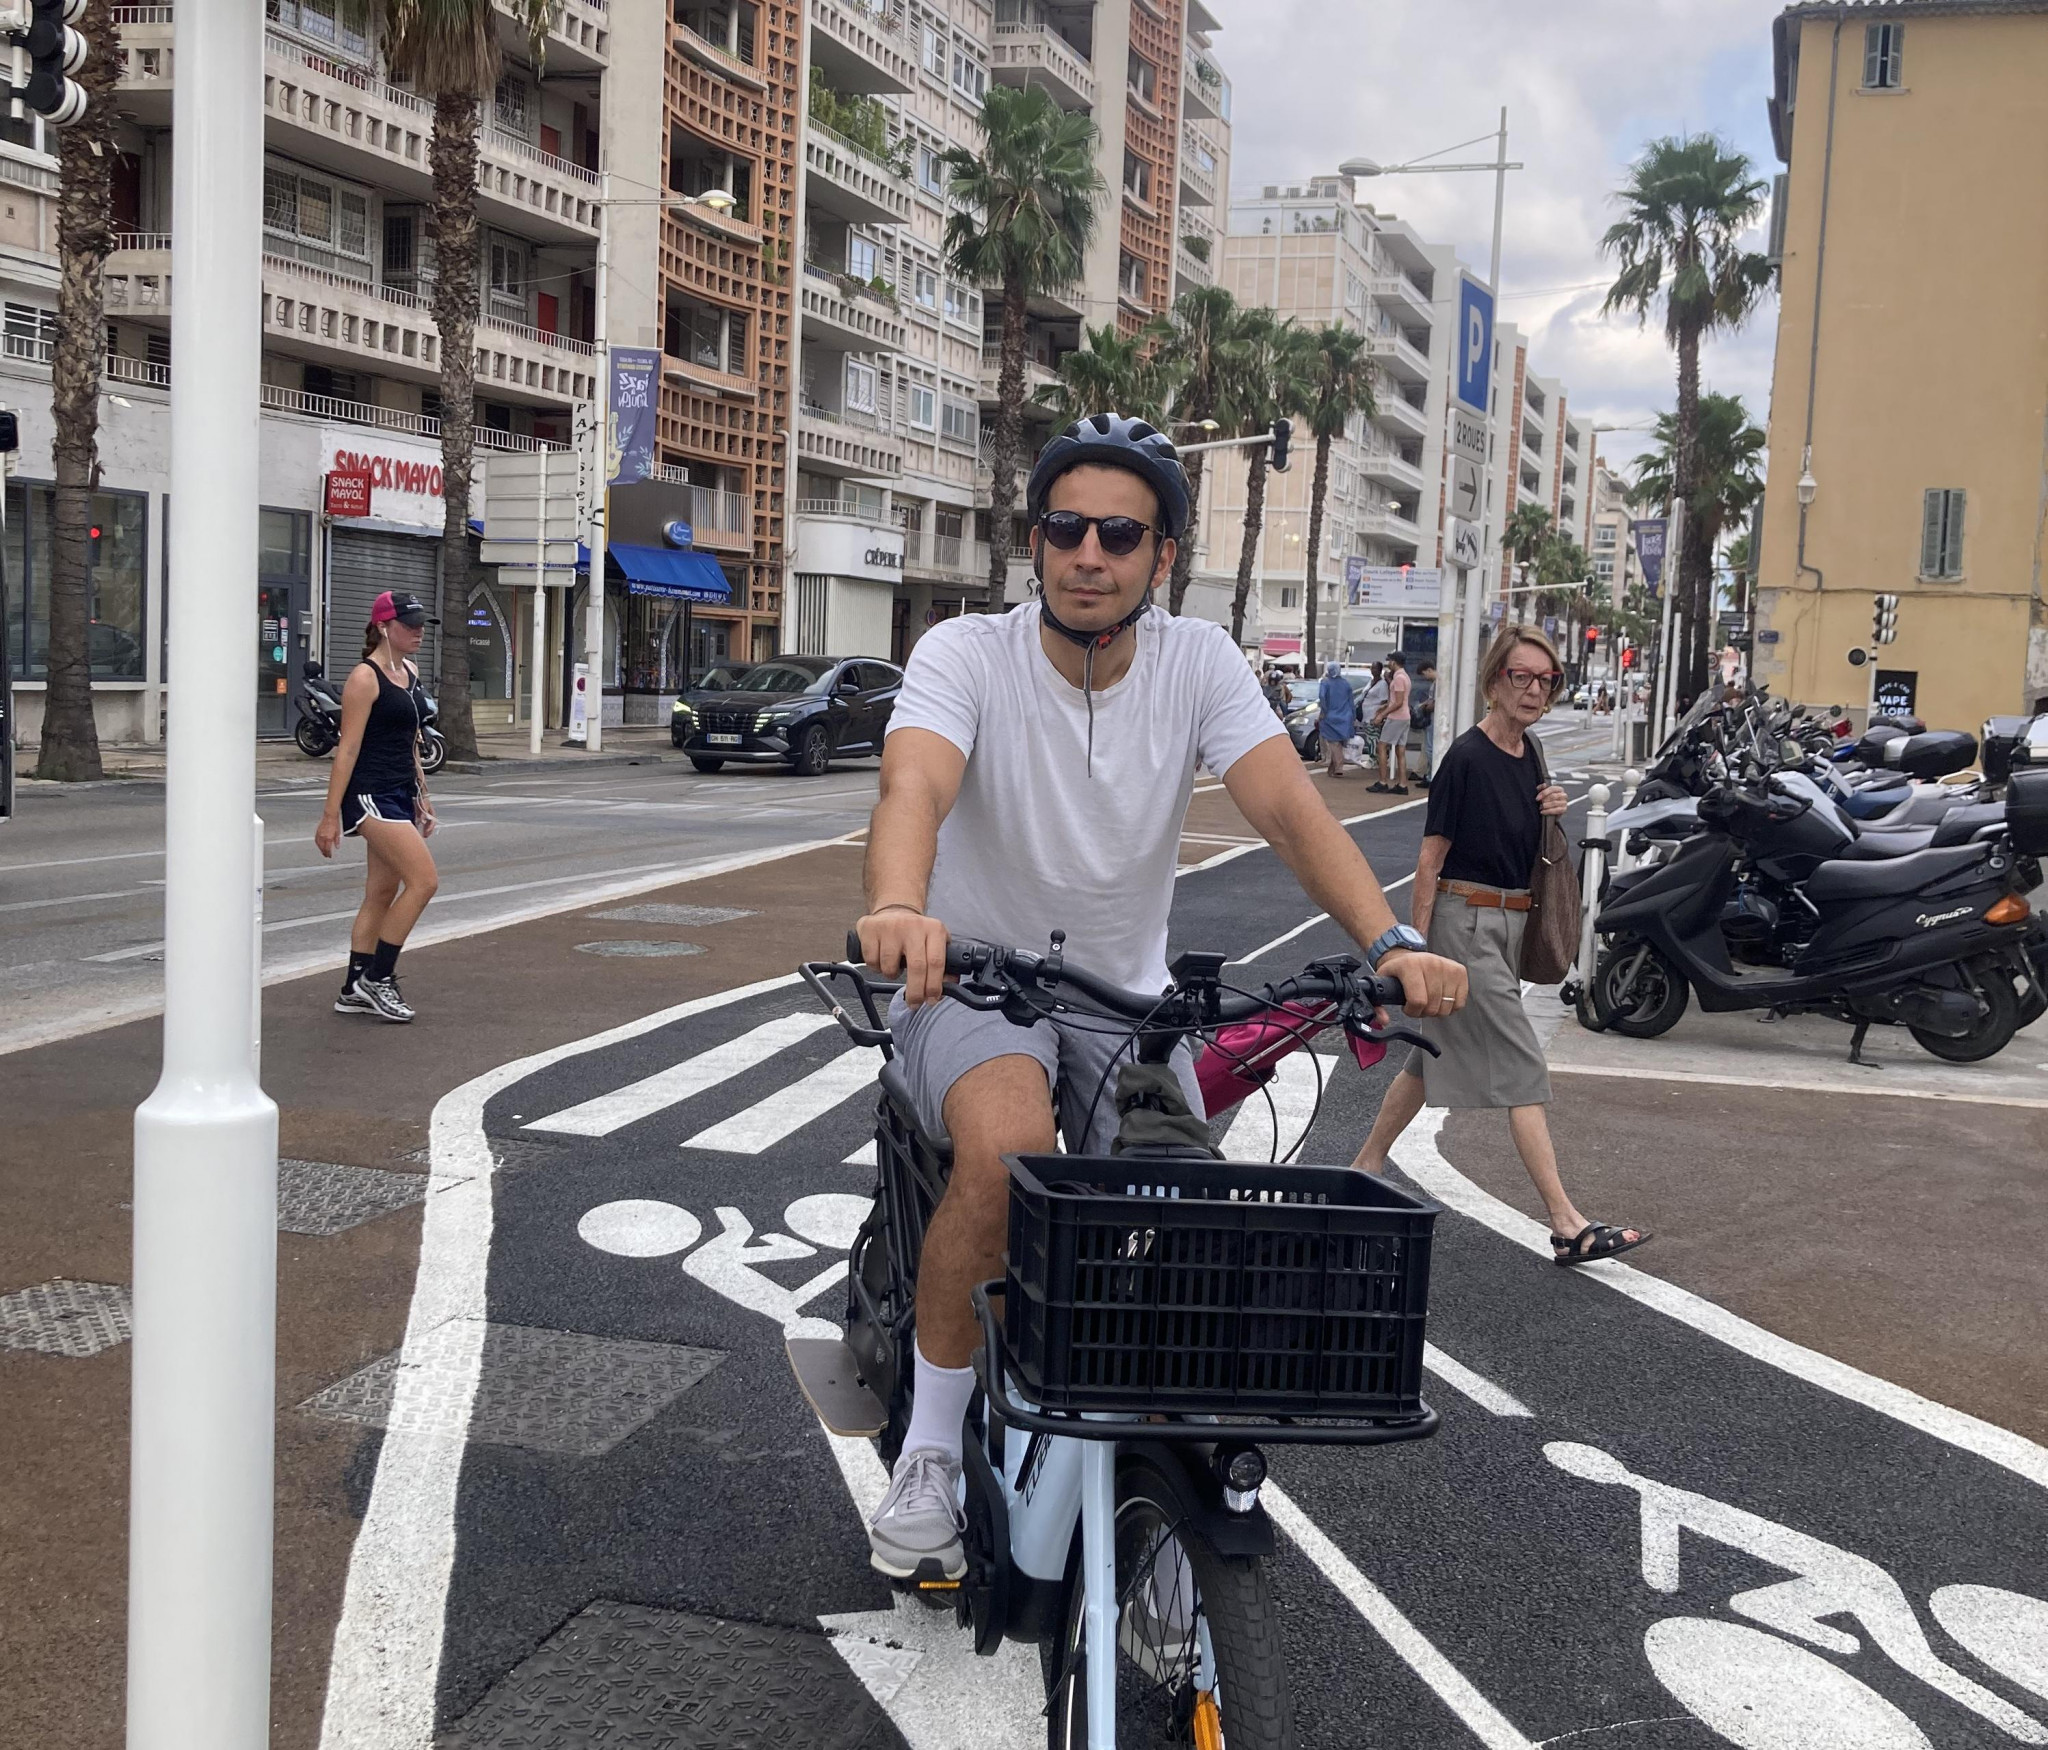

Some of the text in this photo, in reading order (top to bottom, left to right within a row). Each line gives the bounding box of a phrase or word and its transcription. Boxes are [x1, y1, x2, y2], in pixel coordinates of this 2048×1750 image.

[1466, 304, 1484, 383] P
[1462, 422, 1485, 454] ROUES
[335, 449, 444, 498] SNACK MAYO
[331, 476, 364, 489] SNACK
[331, 488, 364, 500] MAYOL
[1879, 695, 1907, 706] VAPE
[1915, 911, 1960, 927] Cygnus
